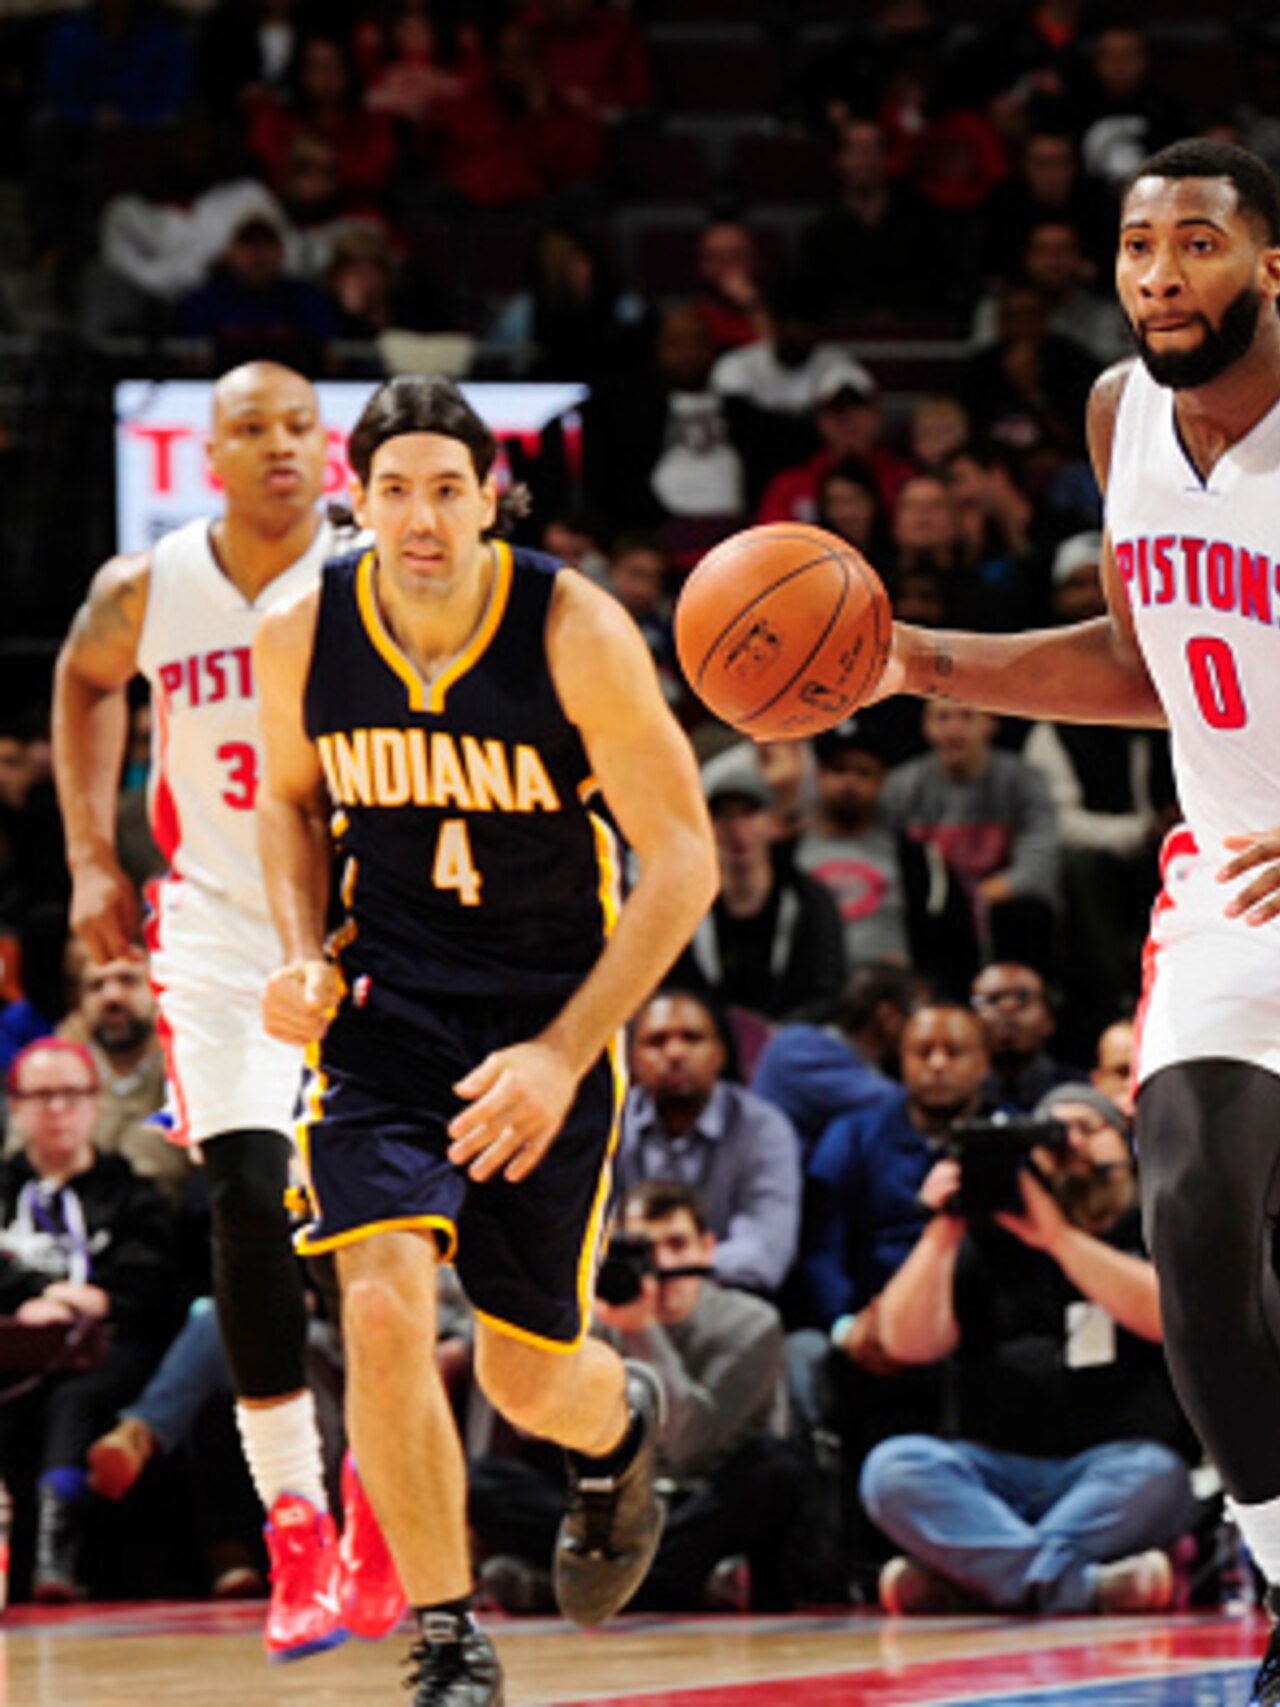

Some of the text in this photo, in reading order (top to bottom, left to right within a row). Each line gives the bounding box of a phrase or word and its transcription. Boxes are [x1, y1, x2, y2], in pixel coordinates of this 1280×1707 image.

[1185, 635, 1248, 730] 0
[316, 727, 563, 813] INDIANA
[433, 817, 483, 907] 4
